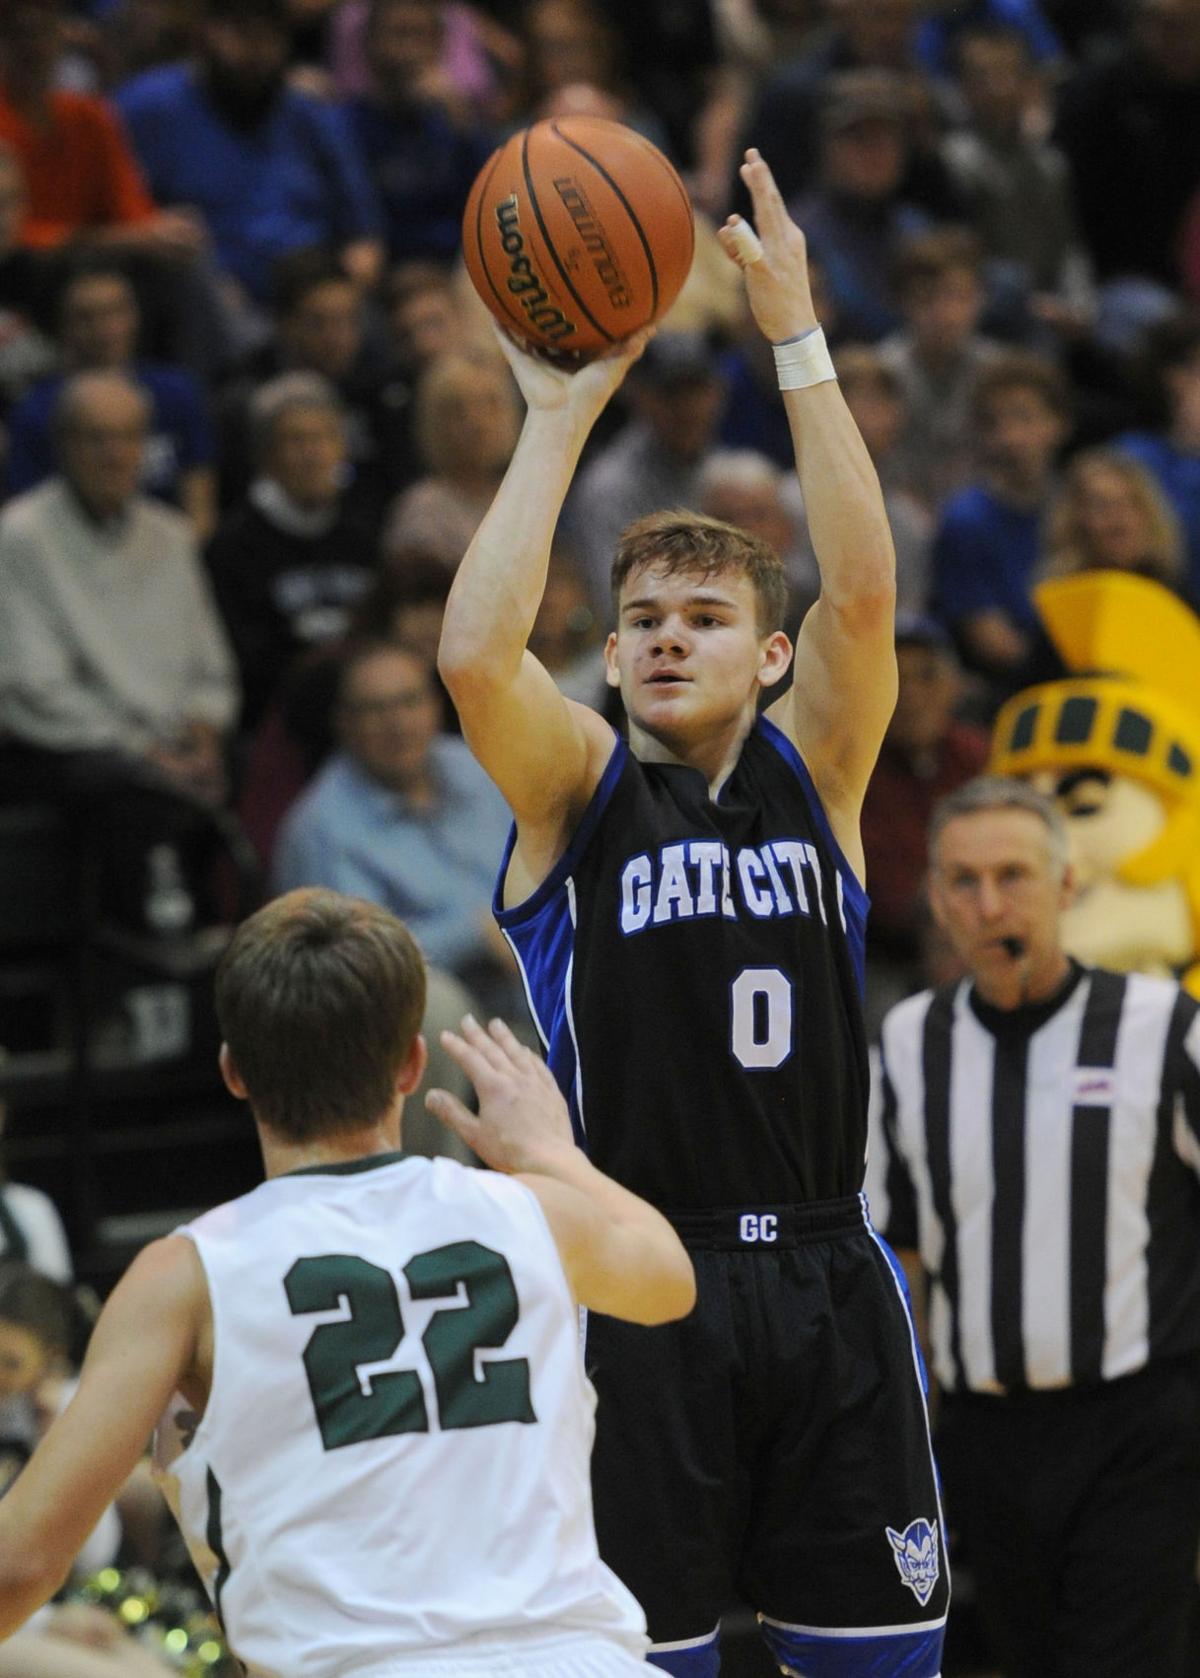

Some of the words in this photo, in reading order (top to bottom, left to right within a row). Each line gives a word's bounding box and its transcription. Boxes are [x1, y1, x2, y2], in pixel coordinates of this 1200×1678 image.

[495, 192, 577, 341] Wilson
[730, 966, 793, 1071] 0
[739, 1213, 778, 1243] GC
[283, 1239, 538, 1452] 22
